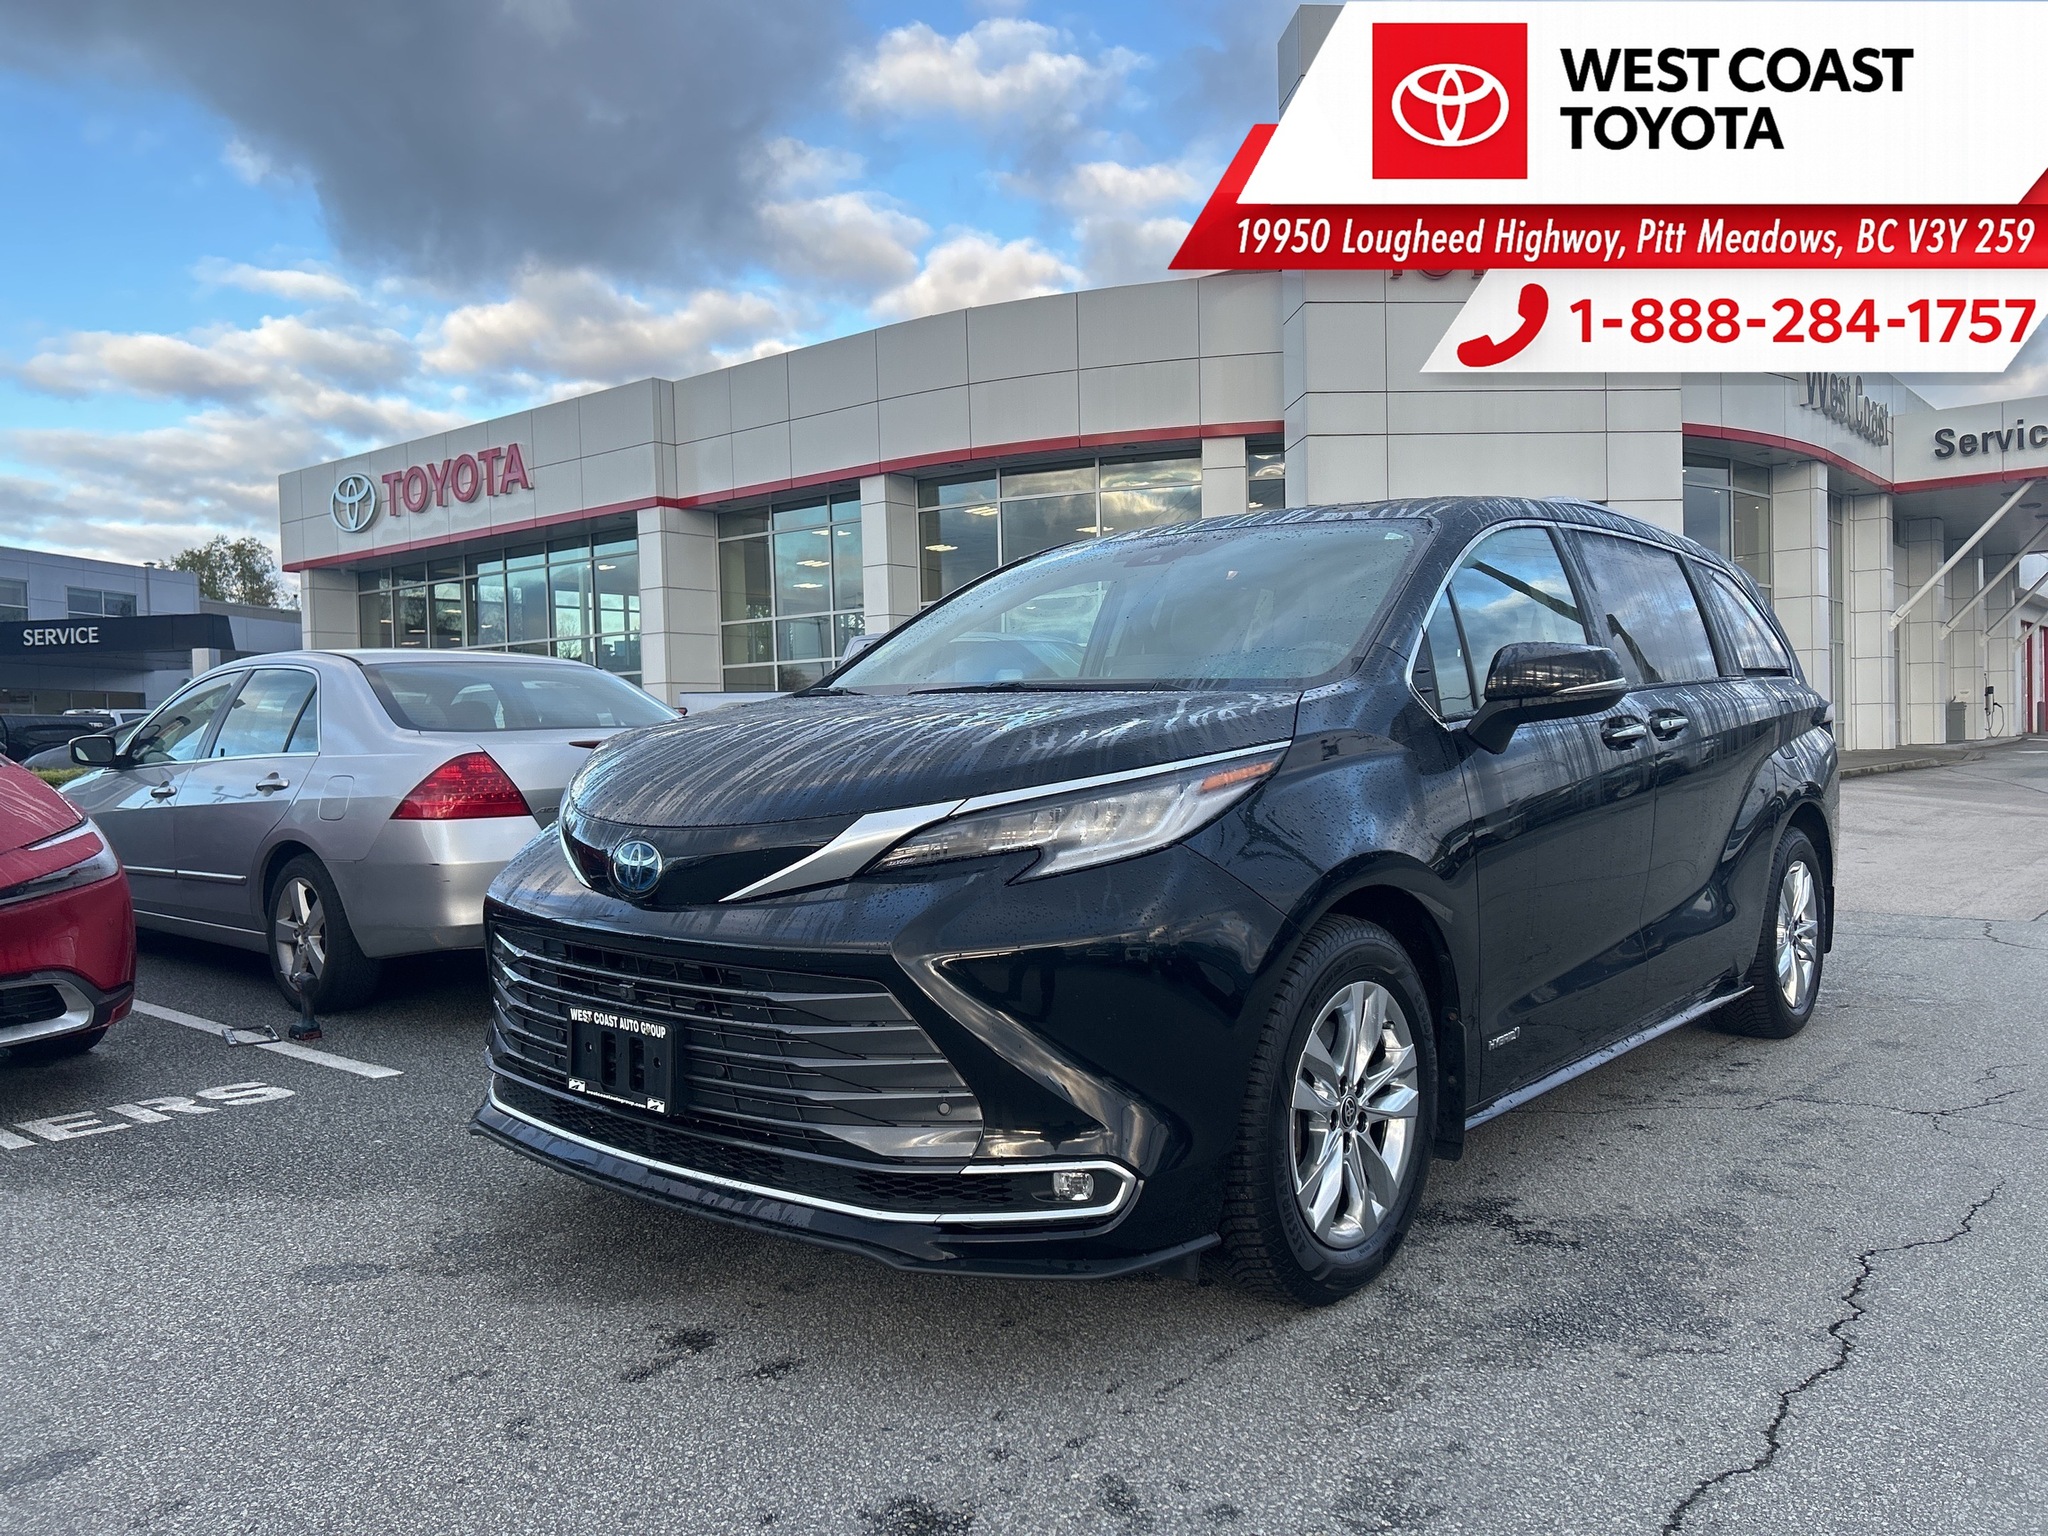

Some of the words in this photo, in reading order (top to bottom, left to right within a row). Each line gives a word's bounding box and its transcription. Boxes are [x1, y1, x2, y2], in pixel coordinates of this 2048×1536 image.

[1800, 372, 1852, 432] West
[1855, 375, 1889, 447] Coast
[381, 442, 535, 518] TOYOTA
[22, 626, 100, 646] SERVICE
[570, 1008, 592, 1023] WEST
[593, 1012, 618, 1028] COAST
[619, 1017, 640, 1033] AUTO
[640, 1022, 666, 1039] GROUP
